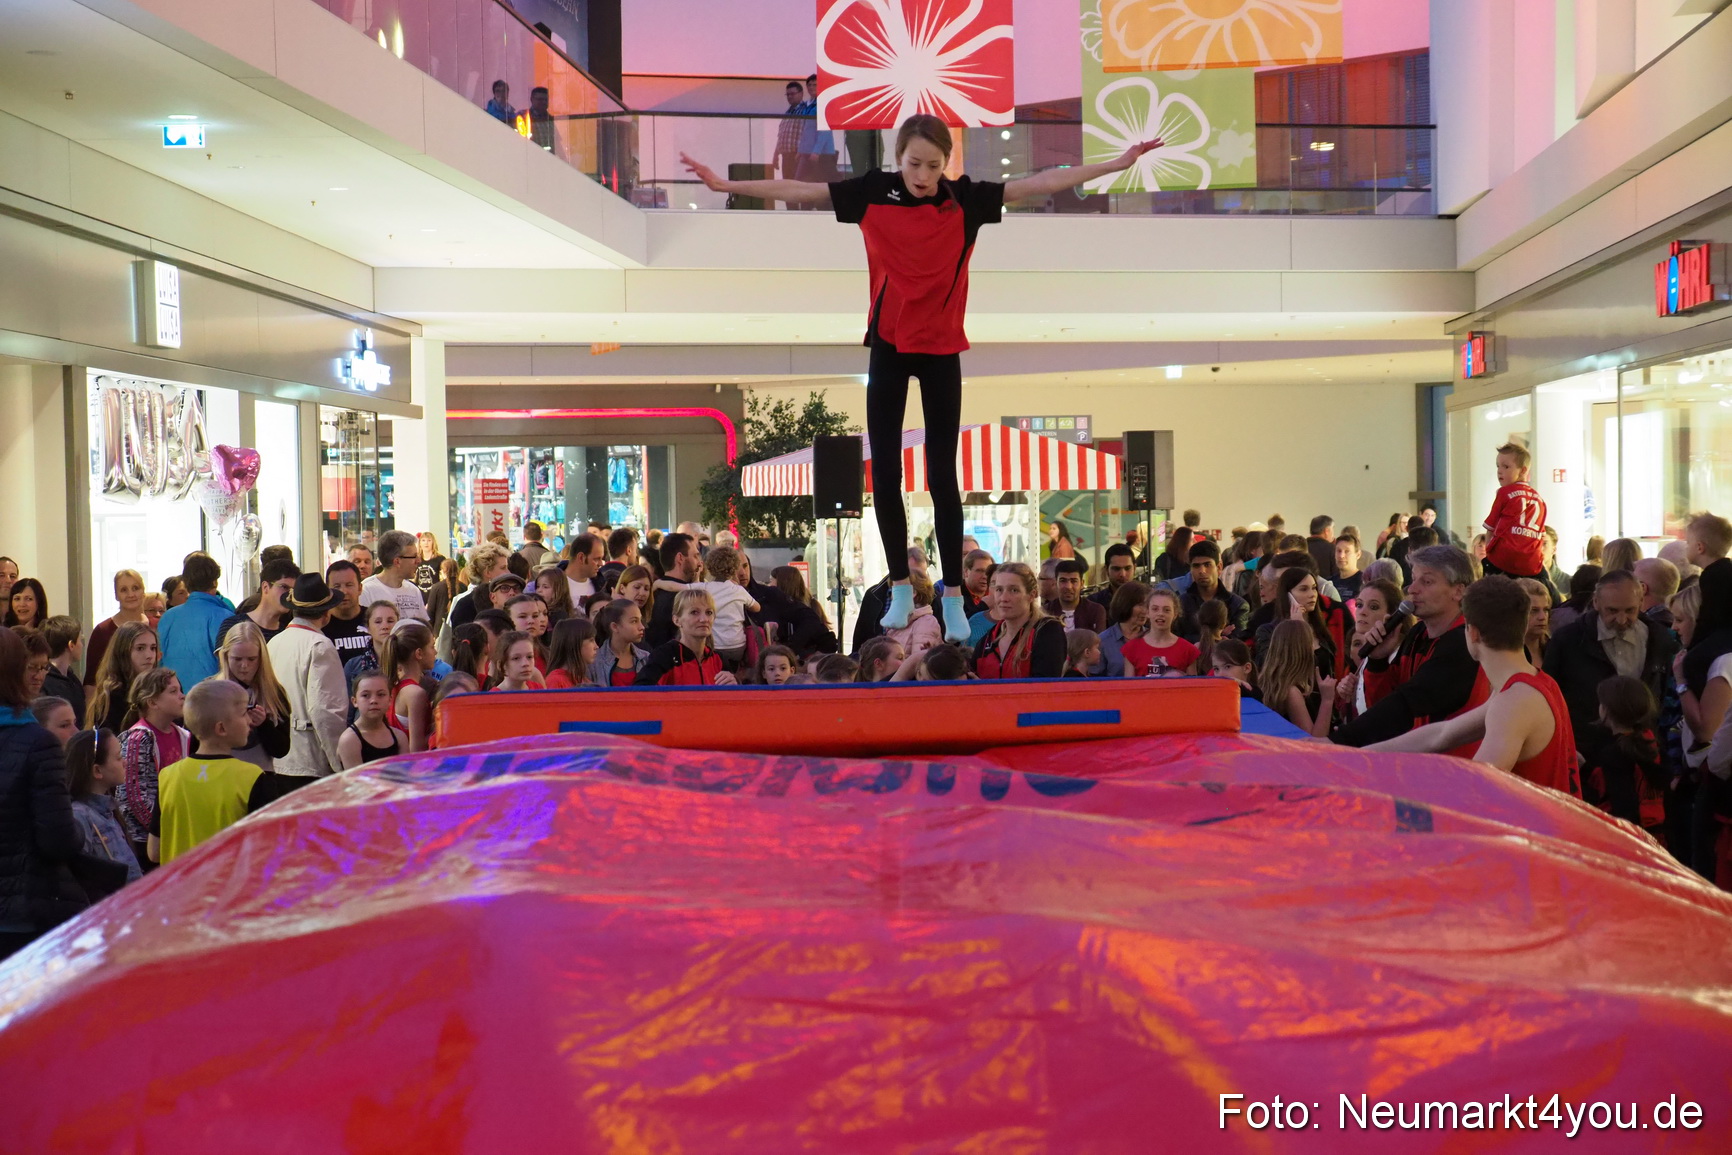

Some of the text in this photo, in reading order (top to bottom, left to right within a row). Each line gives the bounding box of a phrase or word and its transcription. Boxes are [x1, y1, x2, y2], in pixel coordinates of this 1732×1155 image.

[158, 266, 178, 302] LUISA
[1654, 240, 1714, 318] WÖHRL
[160, 305, 180, 343] LUISA
[1461, 331, 1486, 380] WÖHRL
[491, 508, 503, 532] rkt
[1519, 497, 1541, 531] 12
